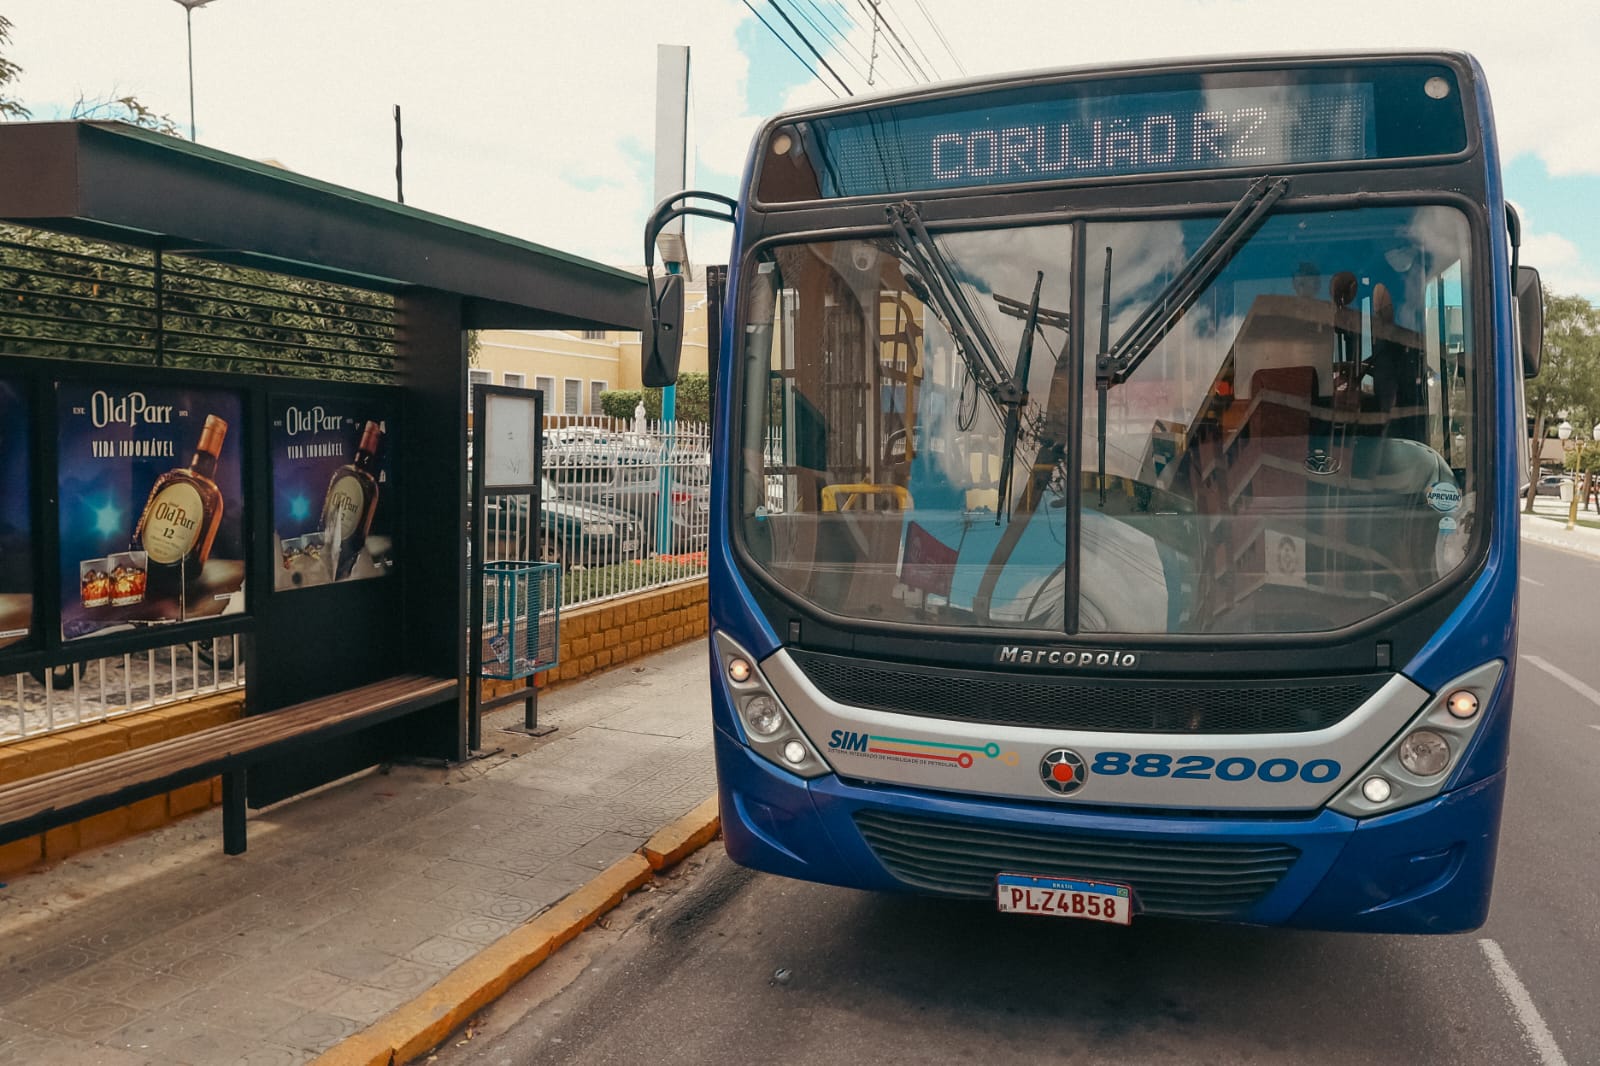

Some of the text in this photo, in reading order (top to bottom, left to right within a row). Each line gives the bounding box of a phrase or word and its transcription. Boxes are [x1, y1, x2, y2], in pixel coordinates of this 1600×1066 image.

[91, 390, 173, 428] Old Parr
[286, 406, 343, 436] Old Parr
[92, 437, 175, 458] VIDA INDOMÁVEL
[155, 502, 196, 530] Old Parr
[163, 527, 175, 539] 12
[999, 646, 1137, 668] Marcopolo
[828, 729, 868, 752] SIM
[1091, 751, 1341, 784] 882000
[1052, 882, 1074, 890] BRASIL
[1011, 887, 1116, 918] PLZ4B58
